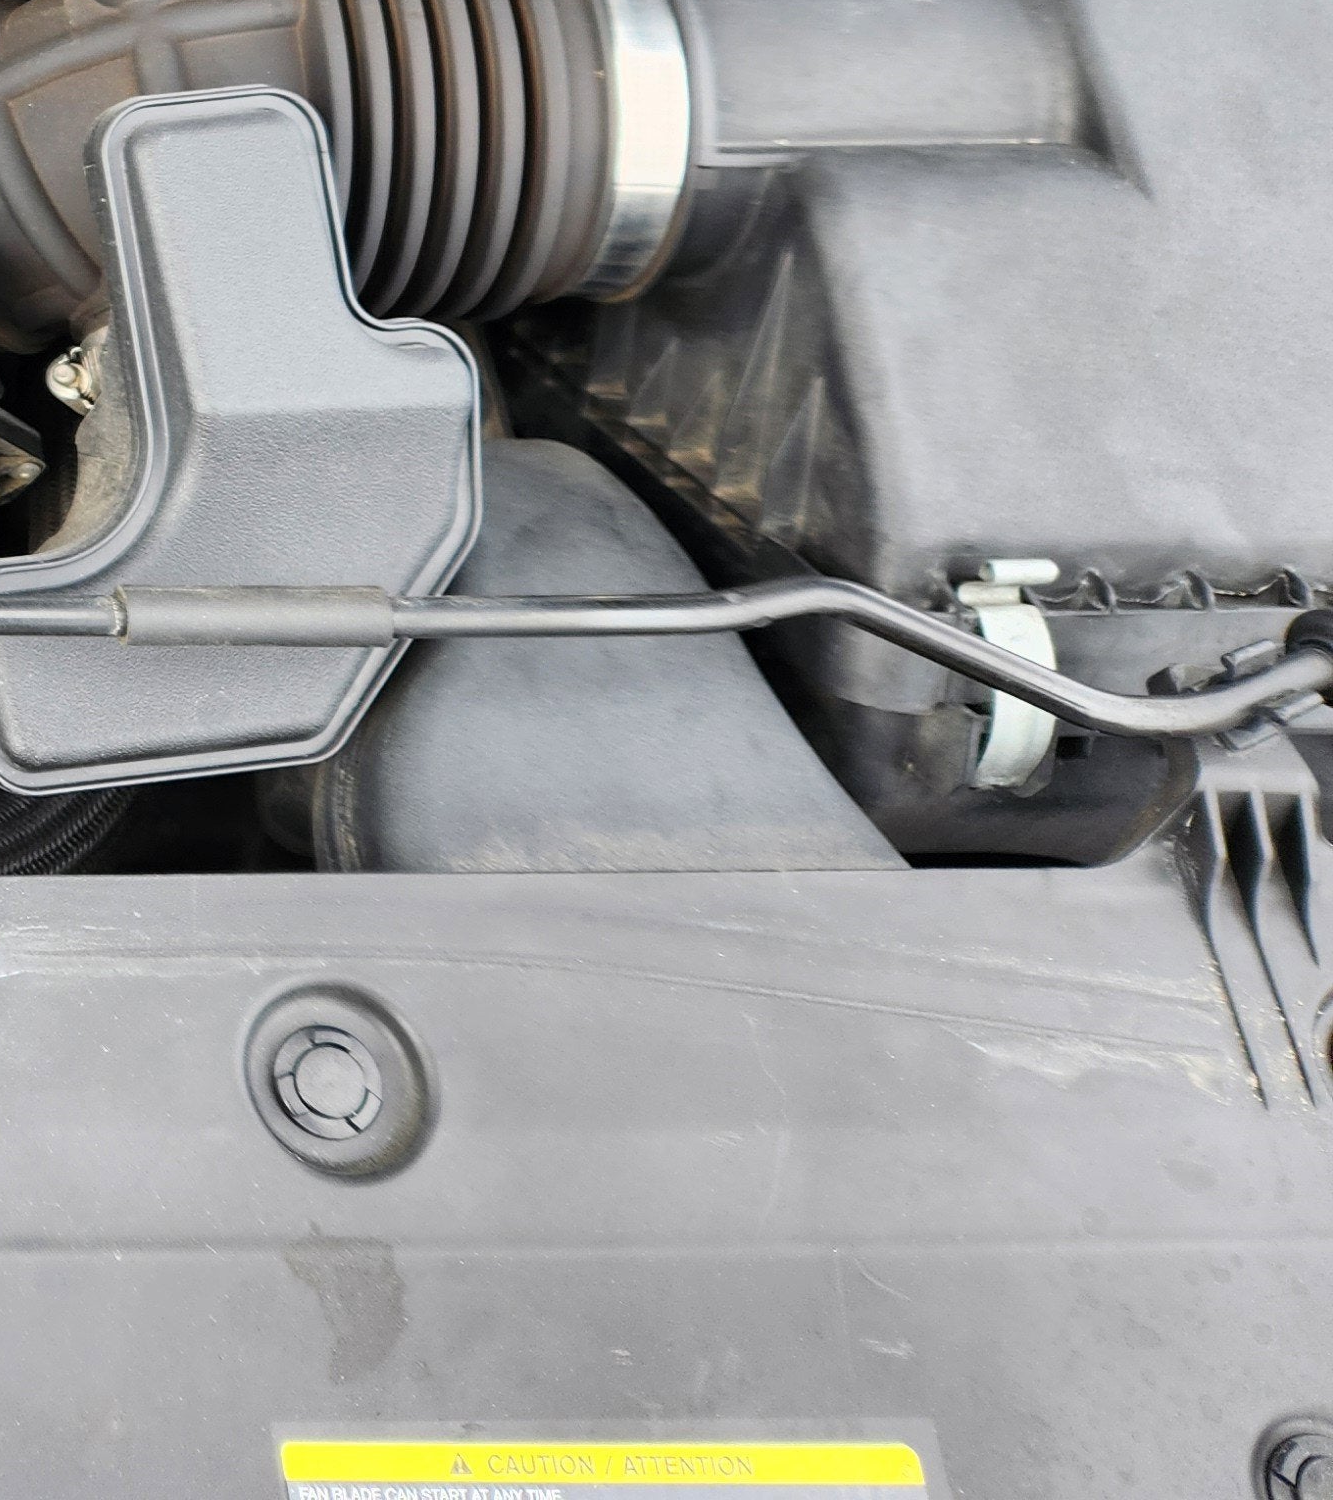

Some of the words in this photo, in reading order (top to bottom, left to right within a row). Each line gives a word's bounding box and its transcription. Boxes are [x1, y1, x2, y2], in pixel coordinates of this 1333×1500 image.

[487, 1455, 595, 1475] CAUTION
[624, 1455, 754, 1476] ATTENTION
[299, 1487, 329, 1500] FAN
[332, 1487, 381, 1500] BLADE
[385, 1487, 418, 1500] CAN
[420, 1487, 467, 1500] START
[472, 1488, 490, 1500] AT
[494, 1488, 523, 1500] ANY
